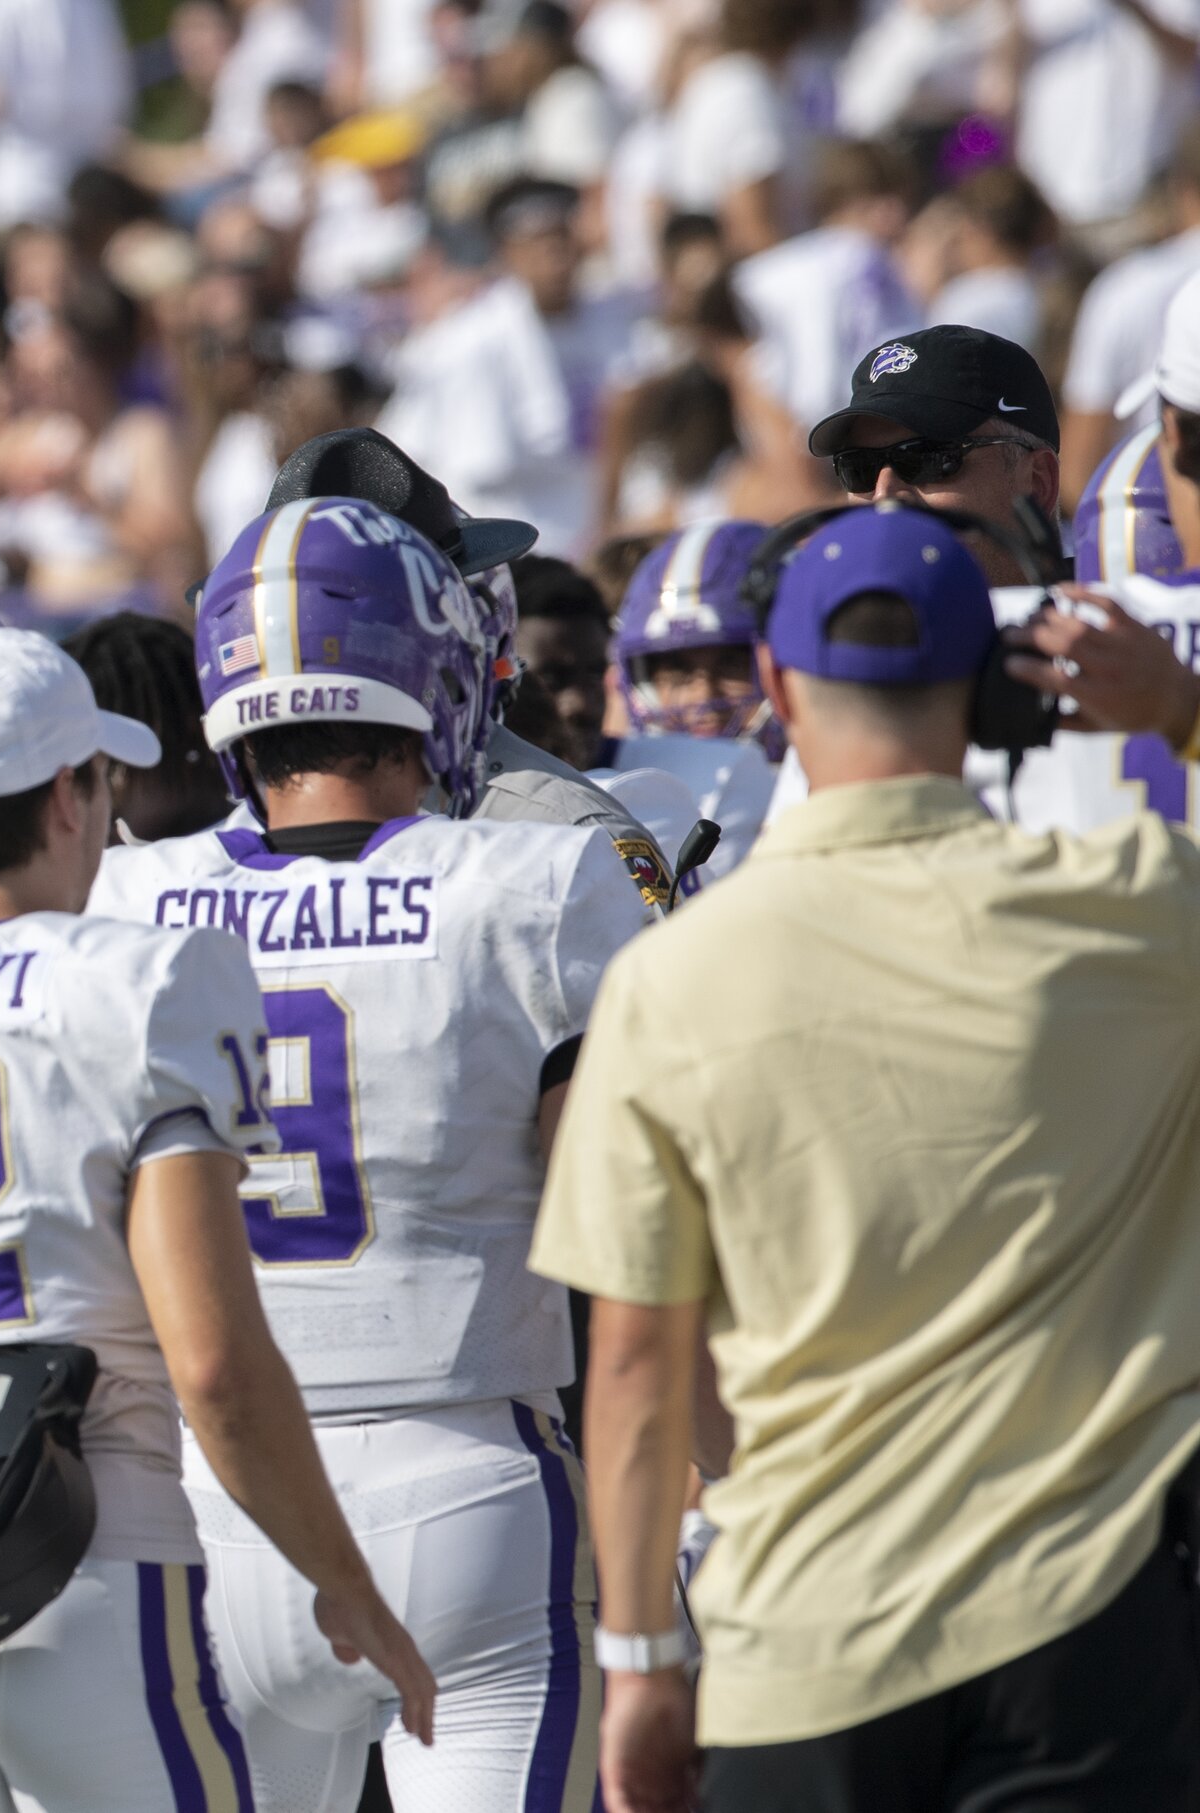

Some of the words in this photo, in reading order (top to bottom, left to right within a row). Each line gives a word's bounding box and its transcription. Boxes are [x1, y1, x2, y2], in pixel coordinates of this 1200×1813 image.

[323, 636, 340, 665] 9
[236, 691, 280, 725] THE
[290, 686, 360, 715] CATS
[155, 876, 432, 952] GONZALES
[241, 981, 377, 1270] 9
